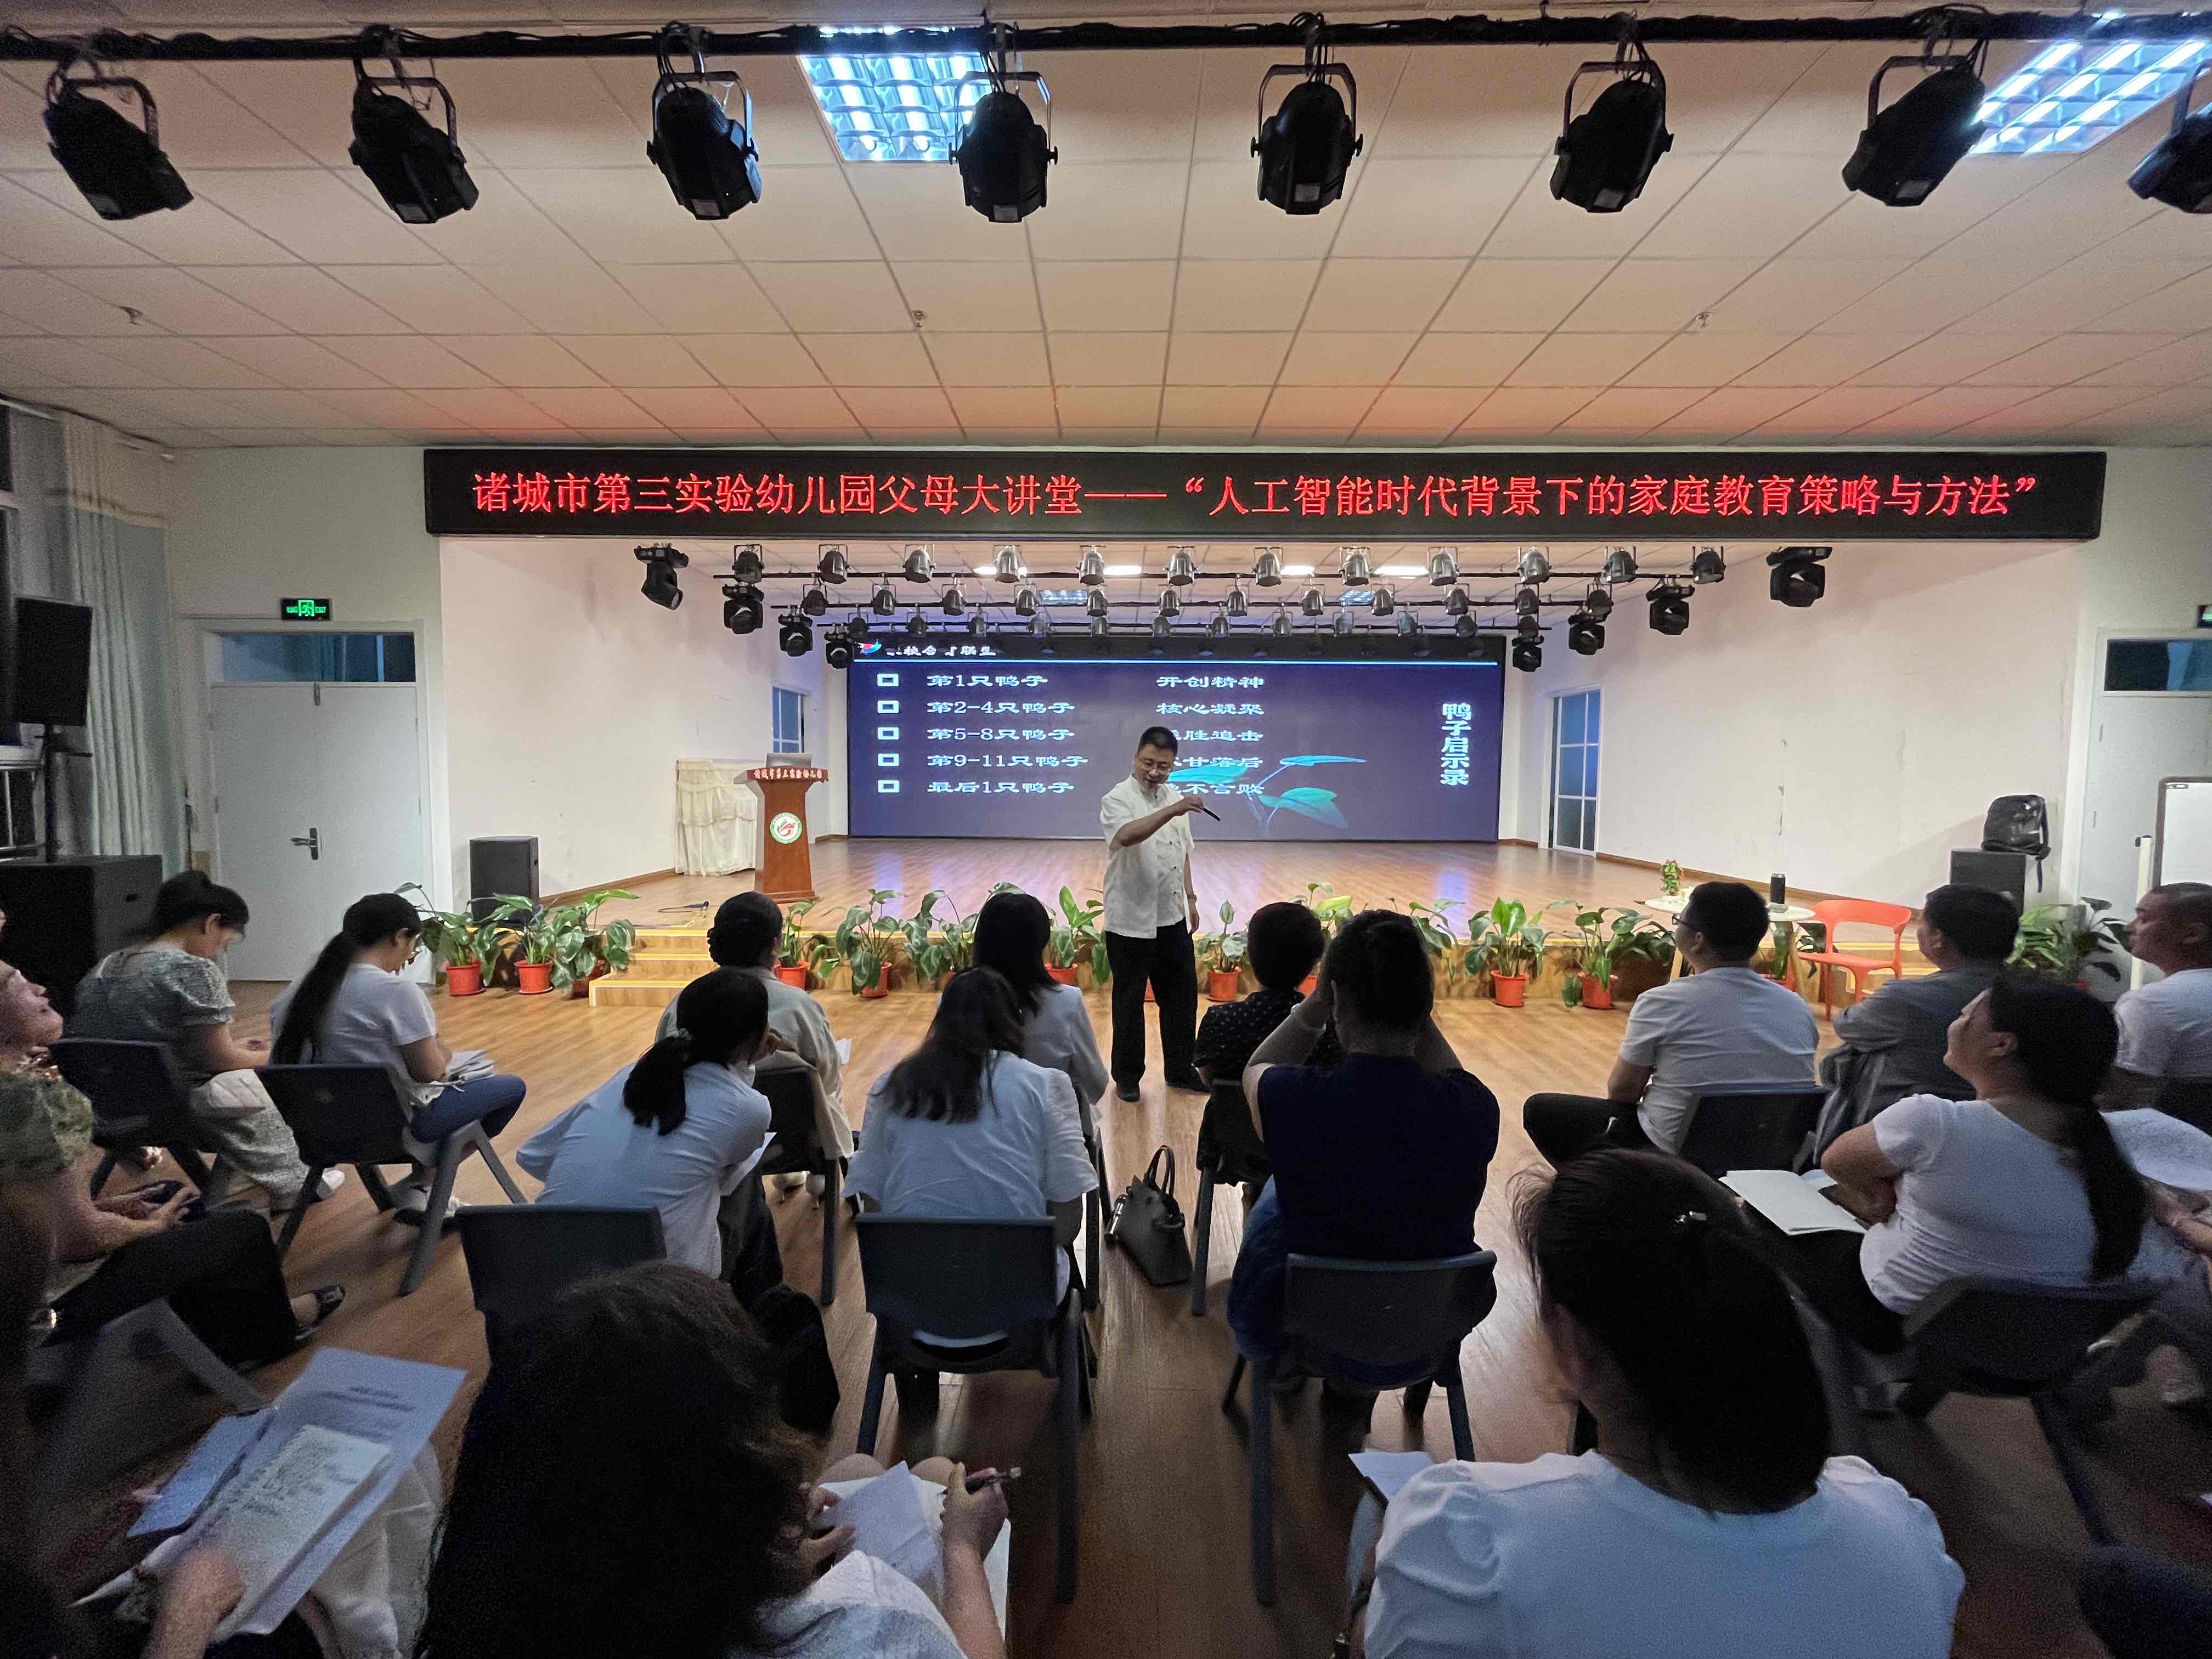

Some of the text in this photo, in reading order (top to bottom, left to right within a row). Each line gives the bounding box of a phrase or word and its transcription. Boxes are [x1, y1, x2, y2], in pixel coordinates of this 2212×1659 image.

[927, 675, 1048, 686] 第1只鸭子
[1156, 676, 1264, 689] 开创精神
[927, 701, 1075, 714] 第2-4只鸭子
[1155, 703, 1265, 715] 核心凝聚
[927, 728, 1075, 740] 第5-8只鸭子
[1440, 703, 1472, 786] 鸭子启示录
[927, 754, 1088, 767] 第9-11只鸭子
[927, 781, 1075, 793] 最后1只鸭子
